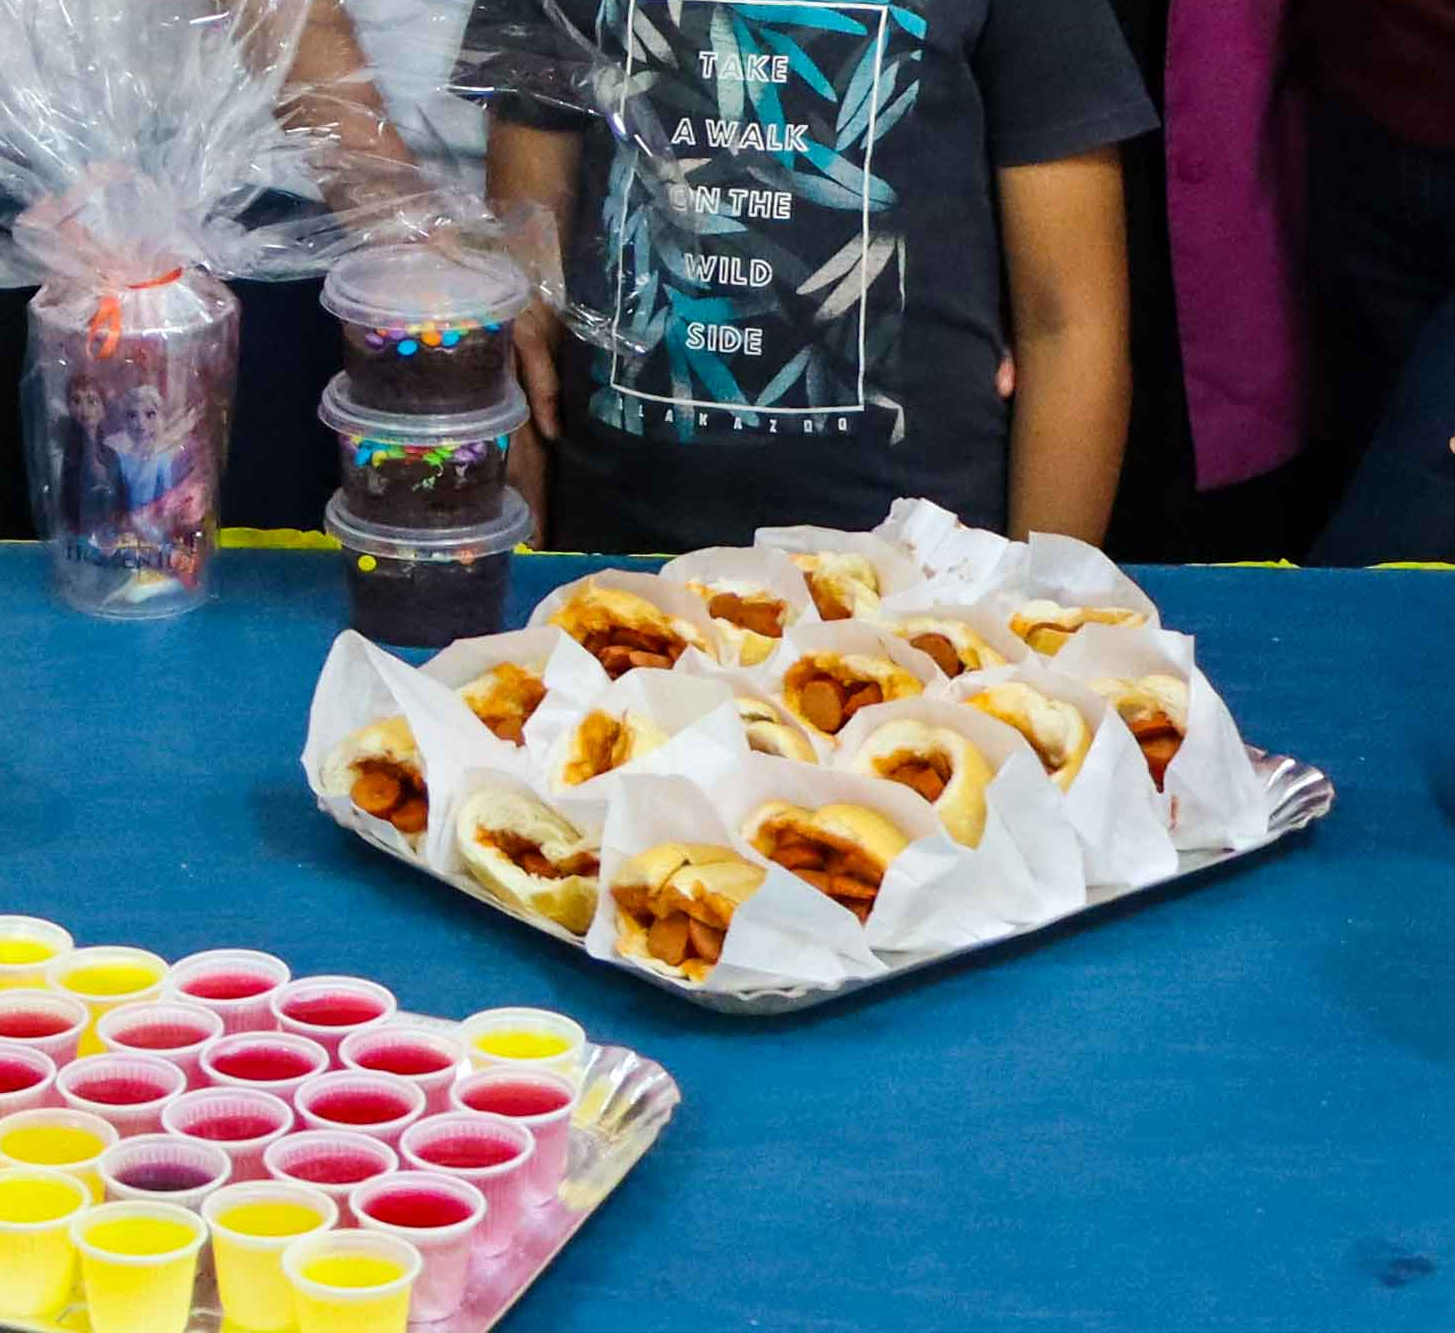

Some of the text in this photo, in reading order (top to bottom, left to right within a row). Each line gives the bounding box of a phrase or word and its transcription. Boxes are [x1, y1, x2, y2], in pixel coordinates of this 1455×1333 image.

[699, 51, 789, 83] TAKE
[671, 117, 809, 153] A WALK
[728, 188, 792, 220] THE
[684, 252, 773, 288] WILD
[685, 321, 764, 357] SIDE
